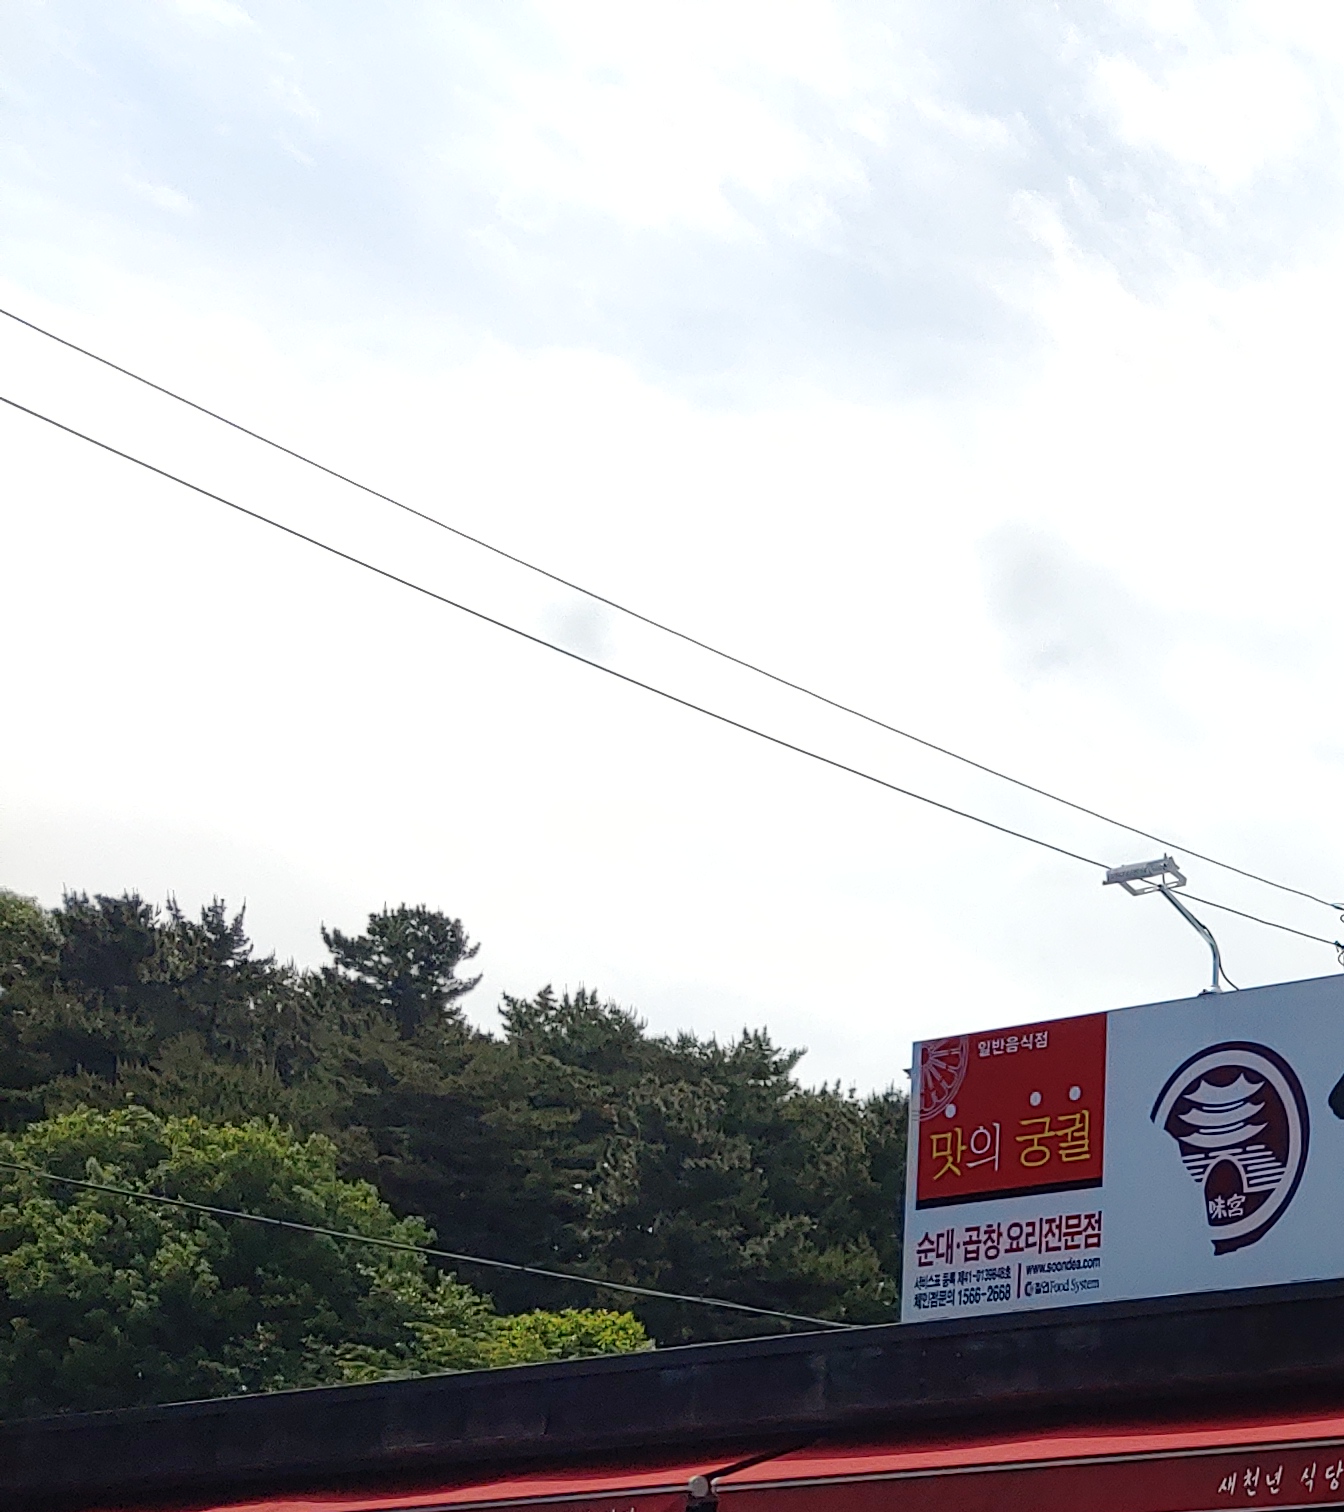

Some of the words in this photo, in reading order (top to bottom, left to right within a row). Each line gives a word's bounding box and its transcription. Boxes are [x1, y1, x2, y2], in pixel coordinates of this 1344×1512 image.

[977, 1030, 1049, 1058] 일반음식점
[931, 1122, 1000, 1181] 맛의
[1015, 1109, 1091, 1168] 궁궐
[1208, 1193, 1246, 1220] 味宮
[1004, 1210, 1102, 1255] 요리전문점
[1217, 1464, 1283, 1497] 새천년
[1300, 1459, 1344, 1493] 식당
